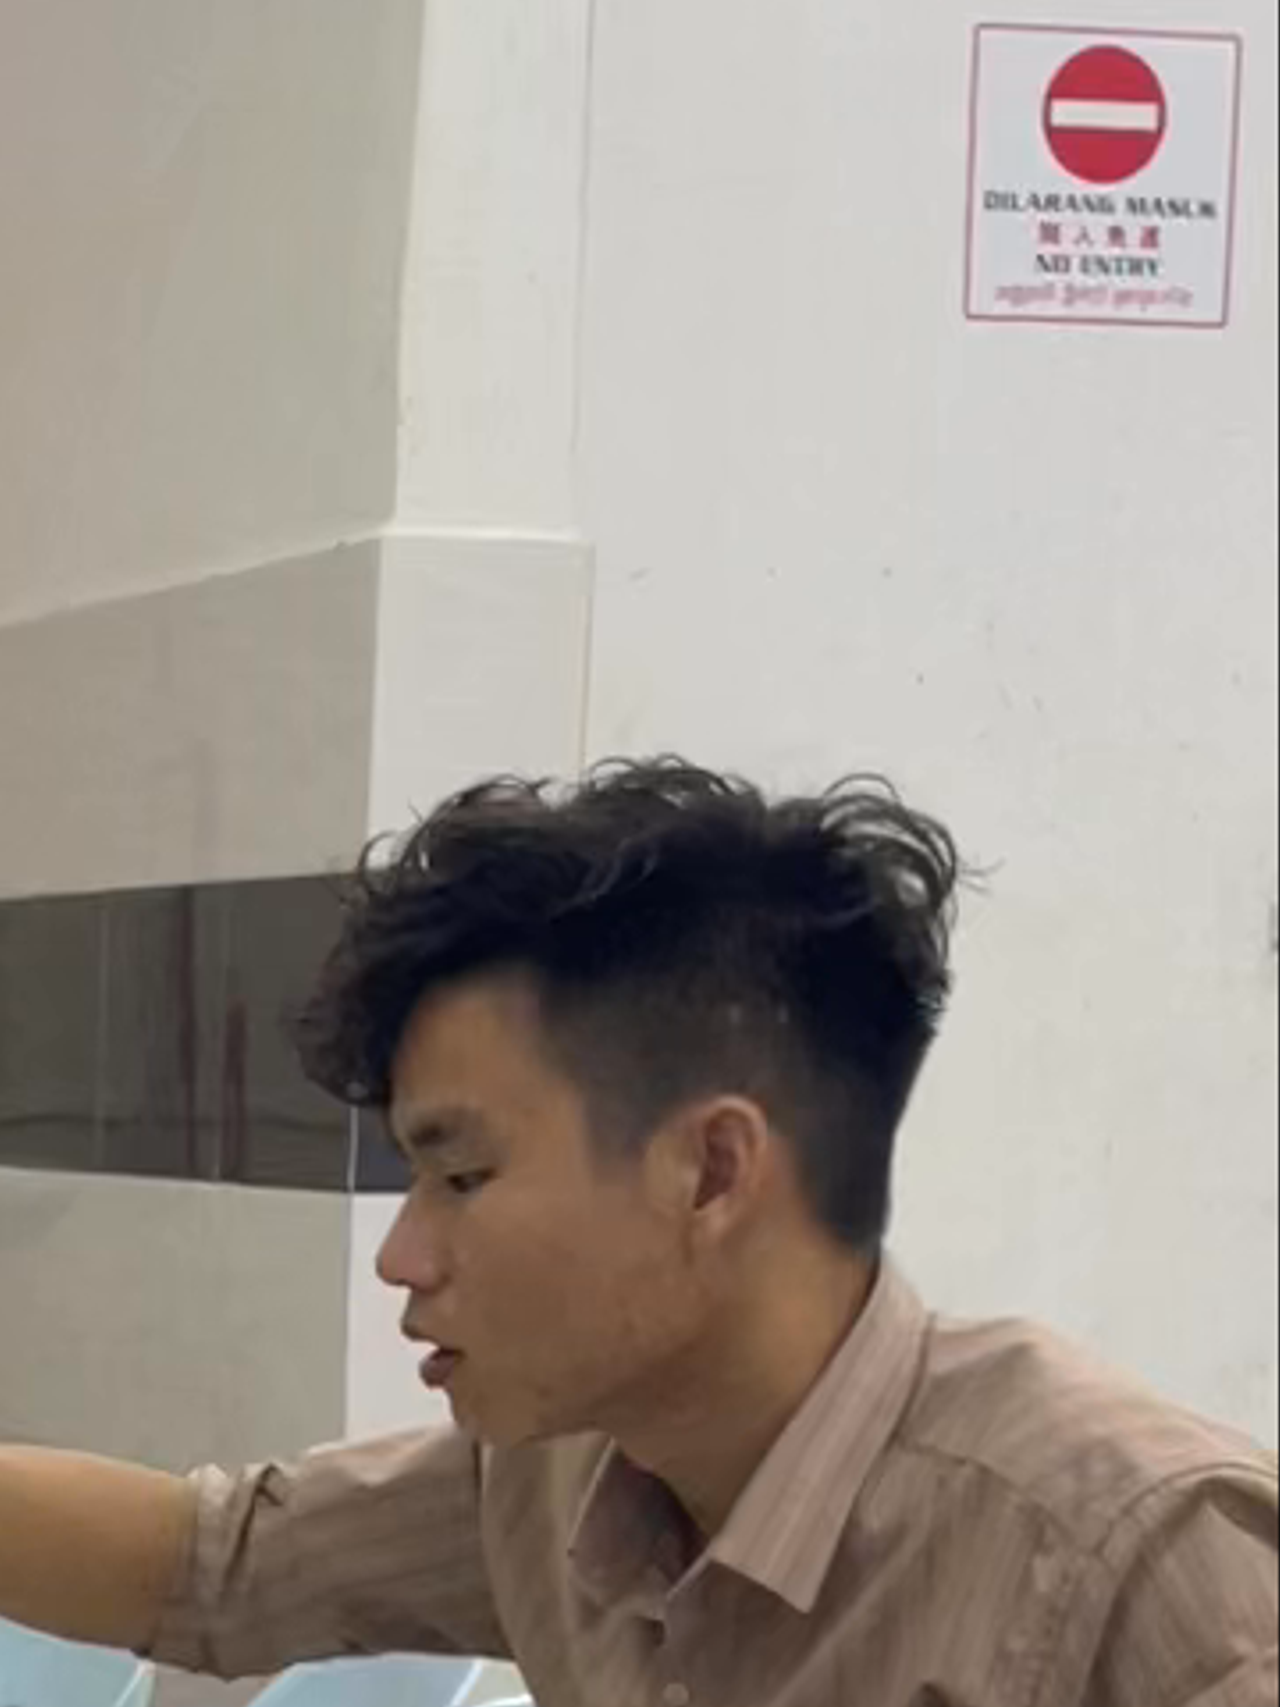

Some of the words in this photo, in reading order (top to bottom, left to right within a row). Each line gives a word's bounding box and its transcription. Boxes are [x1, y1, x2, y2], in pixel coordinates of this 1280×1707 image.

[983, 190, 1116, 215] DILARANG
[1036, 254, 1071, 275] NO
[1080, 255, 1160, 277] ENTRY
